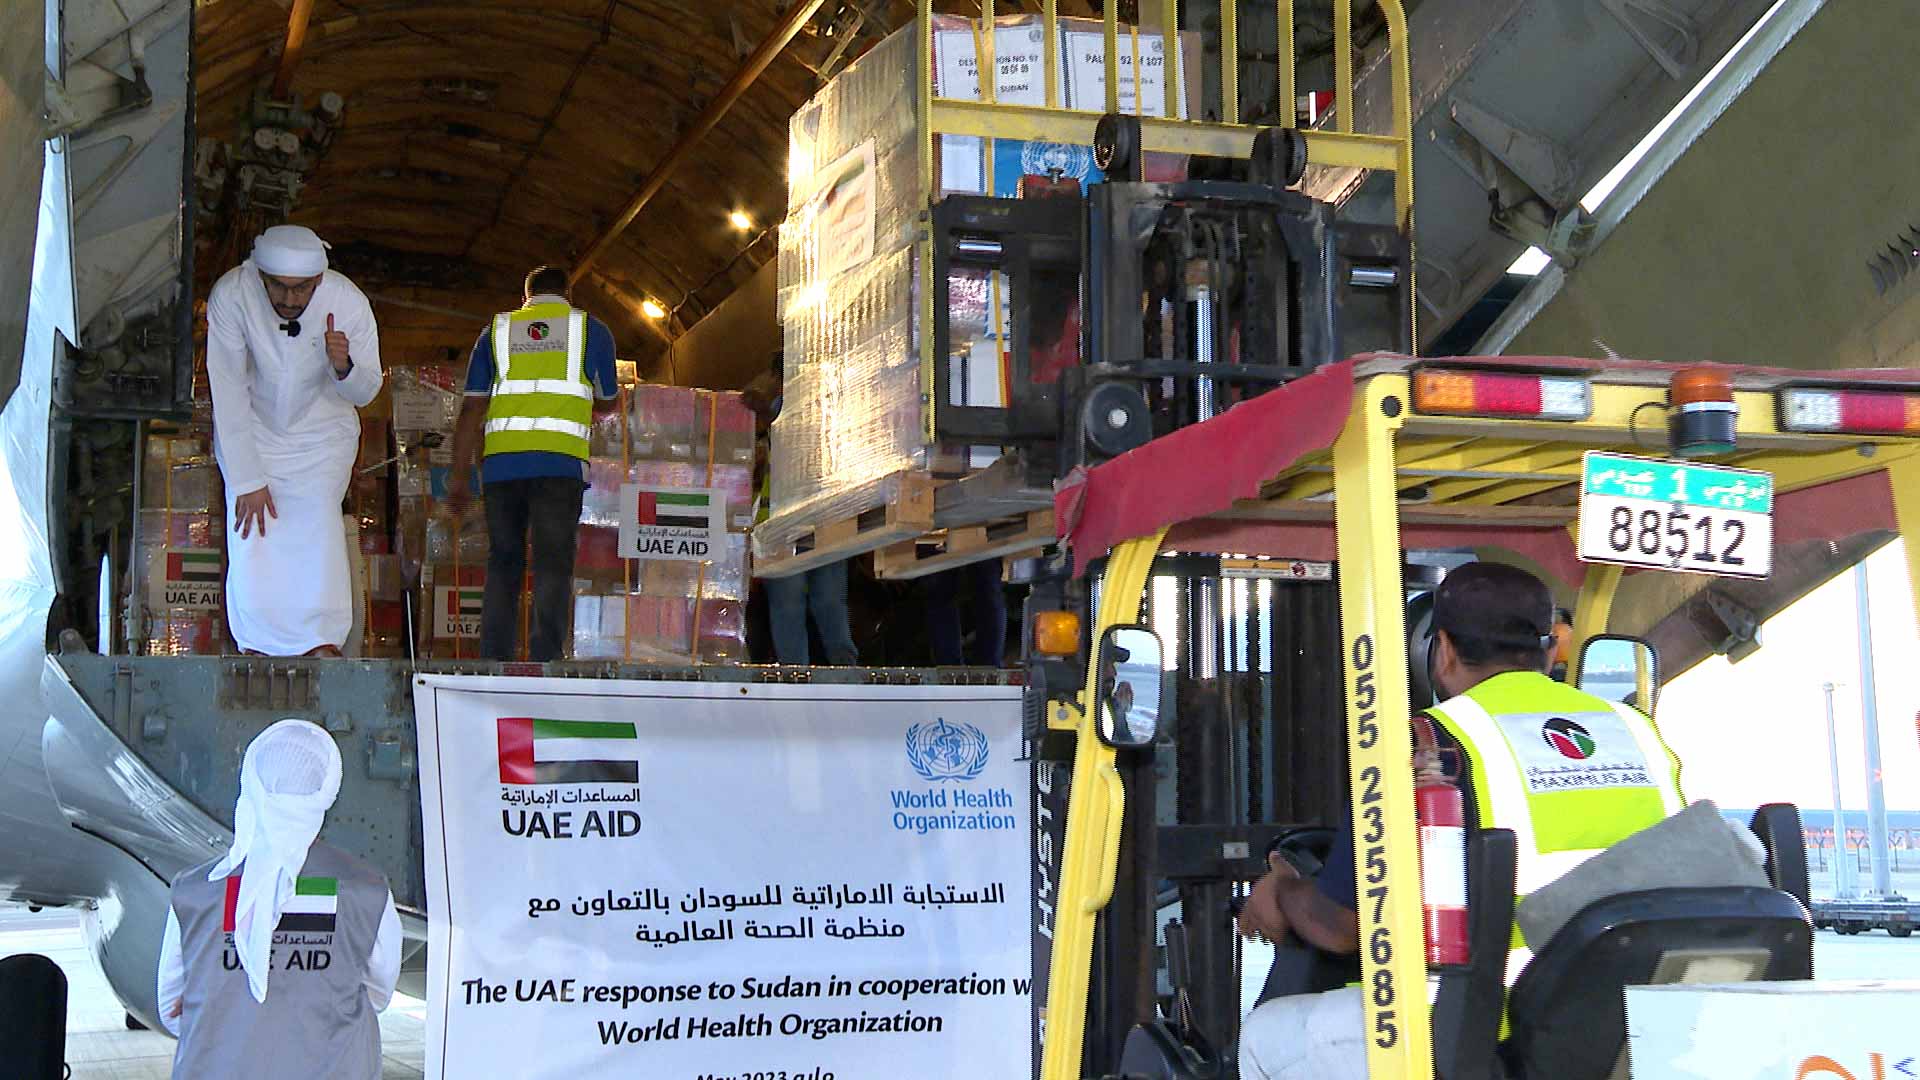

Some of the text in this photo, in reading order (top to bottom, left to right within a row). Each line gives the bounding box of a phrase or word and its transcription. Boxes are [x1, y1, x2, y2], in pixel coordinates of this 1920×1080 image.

[1669, 468, 1688, 501] 1
[637, 538, 709, 555] UAE AID
[1609, 506, 1746, 565] 88512
[166, 591, 197, 604] UAE
[562, 788, 641, 803] المساعدات
[1530, 772, 1652, 790] MAXIMUS AIR
[890, 788, 1013, 809] World Health
[503, 809, 641, 839] UAE AID
[893, 810, 1016, 834] Organization
[1037, 761, 1053, 940] HYSTE
[1352, 634, 1398, 1048] 055 2357685
[528, 882, 1005, 918] الاستجابة الاماراتية للسودان بالتعاون مع
[635, 916, 906, 948] منظمة الصحة العالمية
[285, 950, 332, 971] AID
[461, 977, 507, 1005] The
[515, 978, 576, 1002] UAE
[582, 981, 701, 1009] response
[708, 981, 736, 1000] to
[740, 975, 822, 999] Sudan
[828, 975, 851, 997] in
[858, 972, 1006, 1000] cooperation
[597, 1010, 943, 1045] World Health Organization
